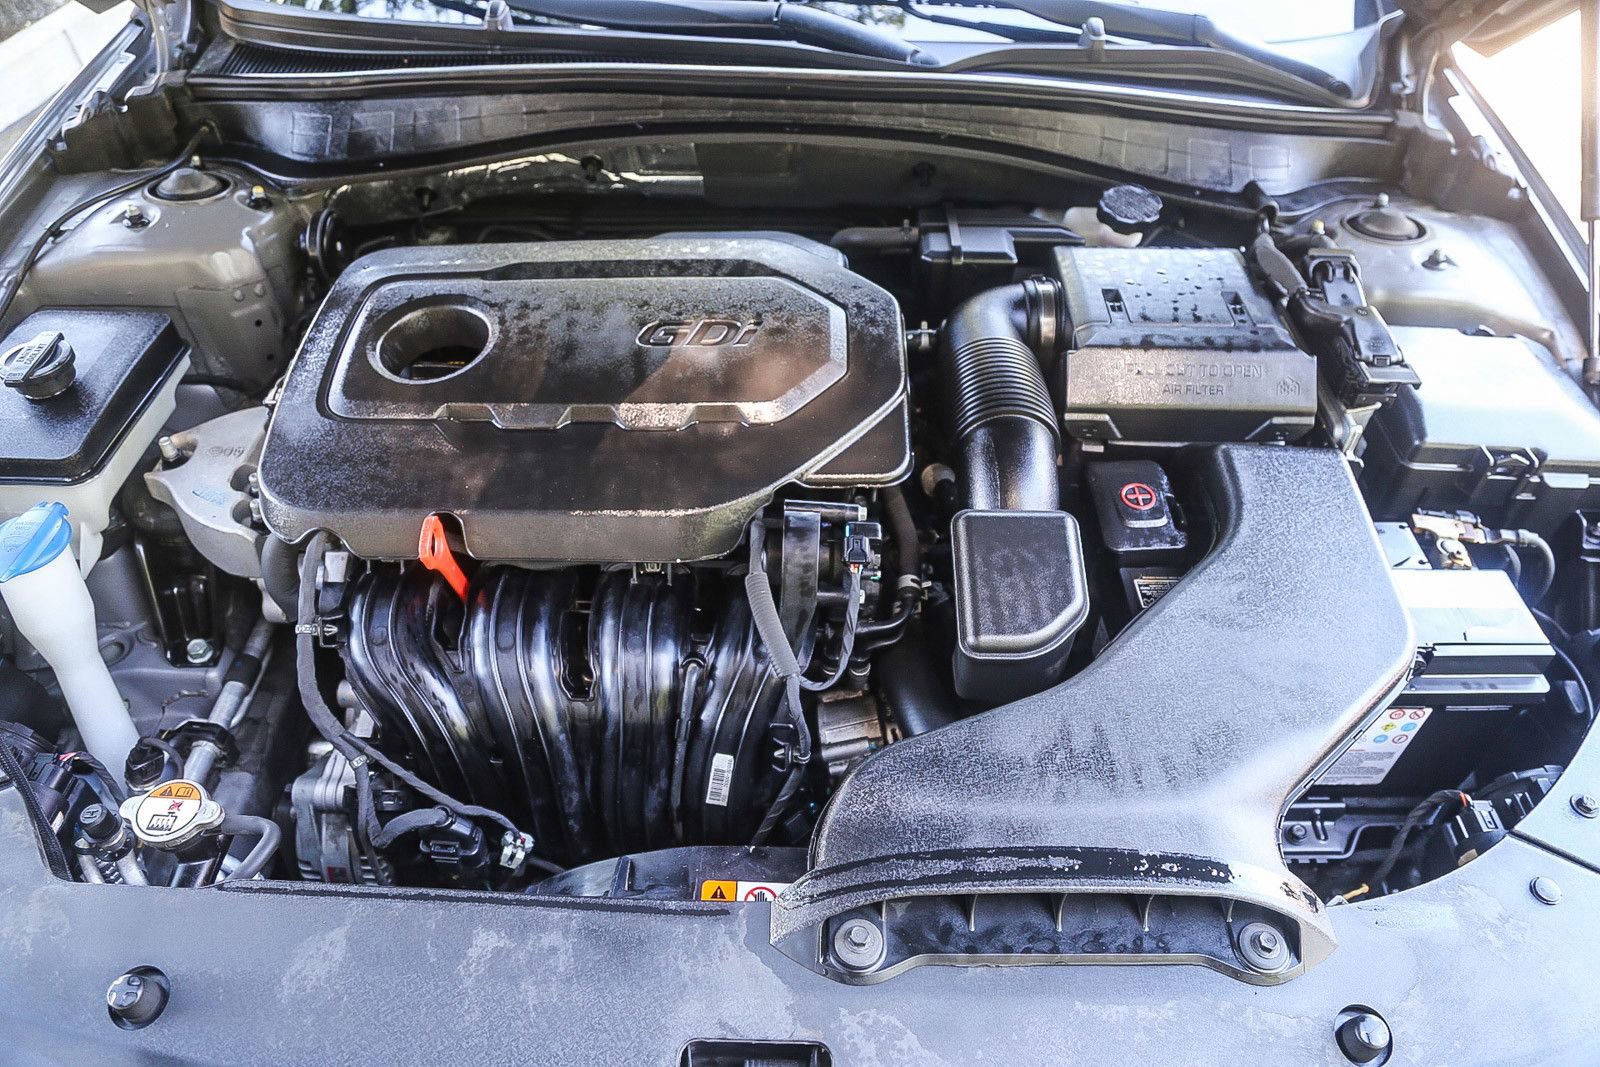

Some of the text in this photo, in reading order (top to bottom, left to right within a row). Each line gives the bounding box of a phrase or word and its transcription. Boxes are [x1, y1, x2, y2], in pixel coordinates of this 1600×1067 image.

[1199, 364, 1219, 378] TO
[1222, 364, 1262, 378] OPEN
[1163, 384, 1224, 395] AIR FILTER
